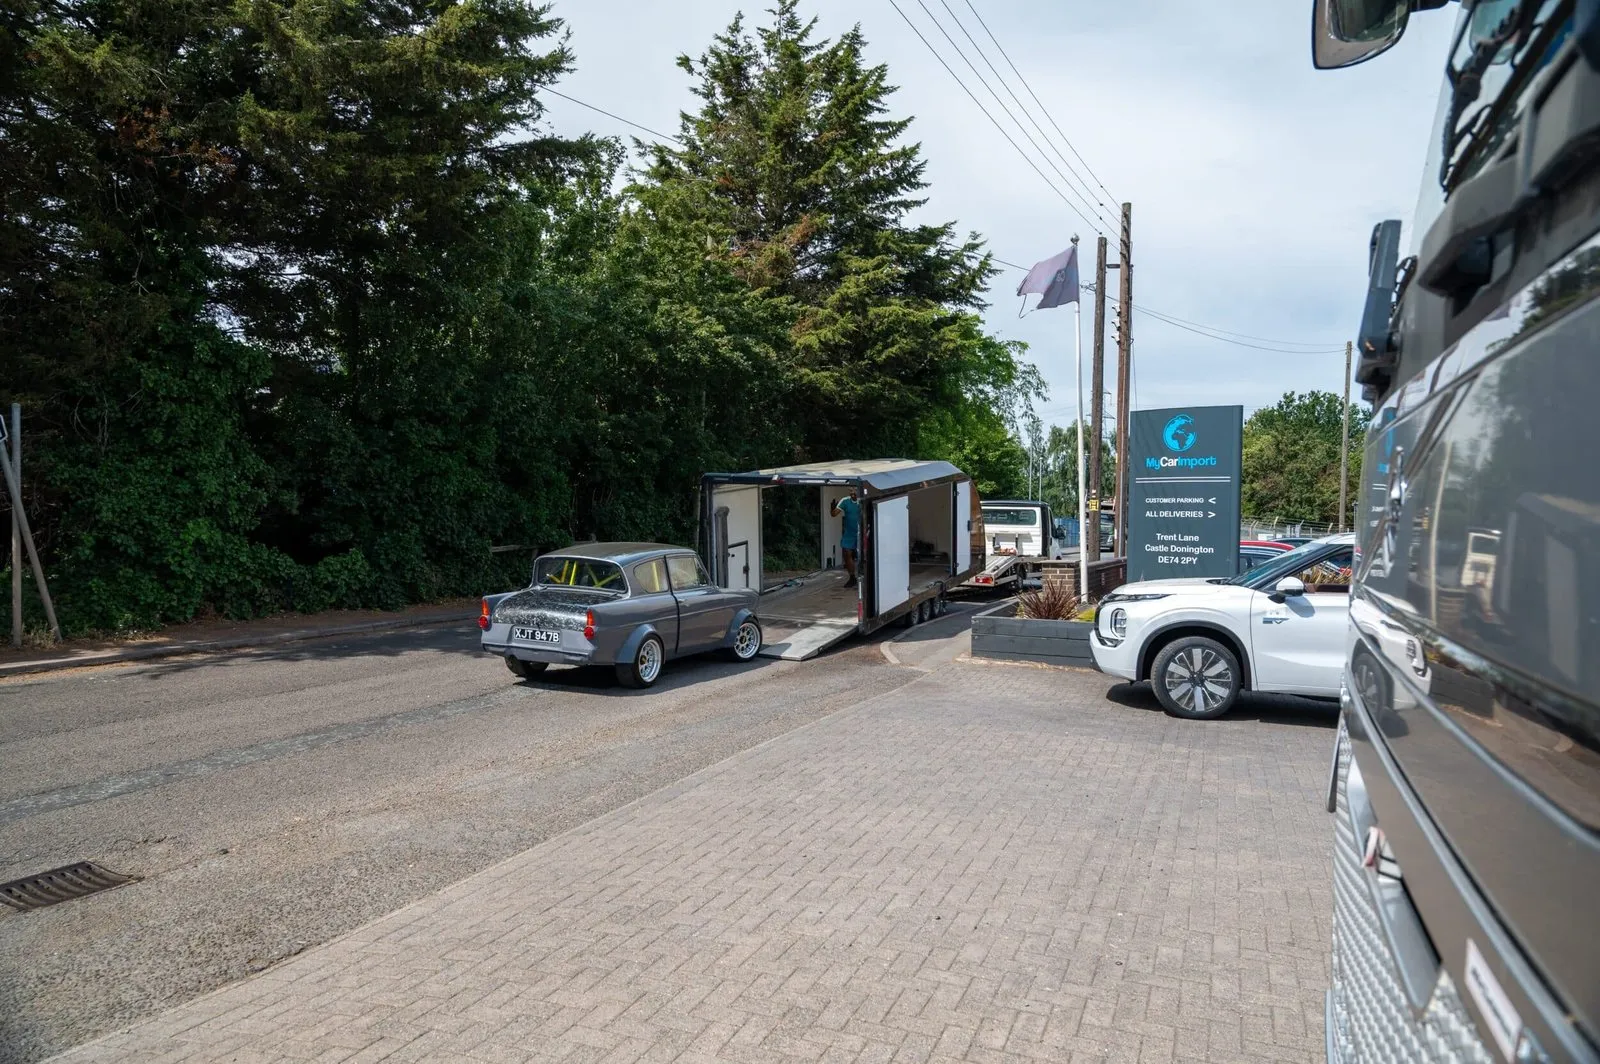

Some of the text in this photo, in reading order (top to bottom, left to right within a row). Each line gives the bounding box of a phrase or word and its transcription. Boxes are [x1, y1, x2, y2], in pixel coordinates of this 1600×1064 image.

[1145, 510, 1204, 518] ALL DELIVERIES
[1156, 533, 1200, 542] Trent Lane
[1145, 544, 1214, 555] Castle Donington
[1158, 556, 1198, 565] DE74 2PY
[515, 628, 560, 643] XJT 947B
